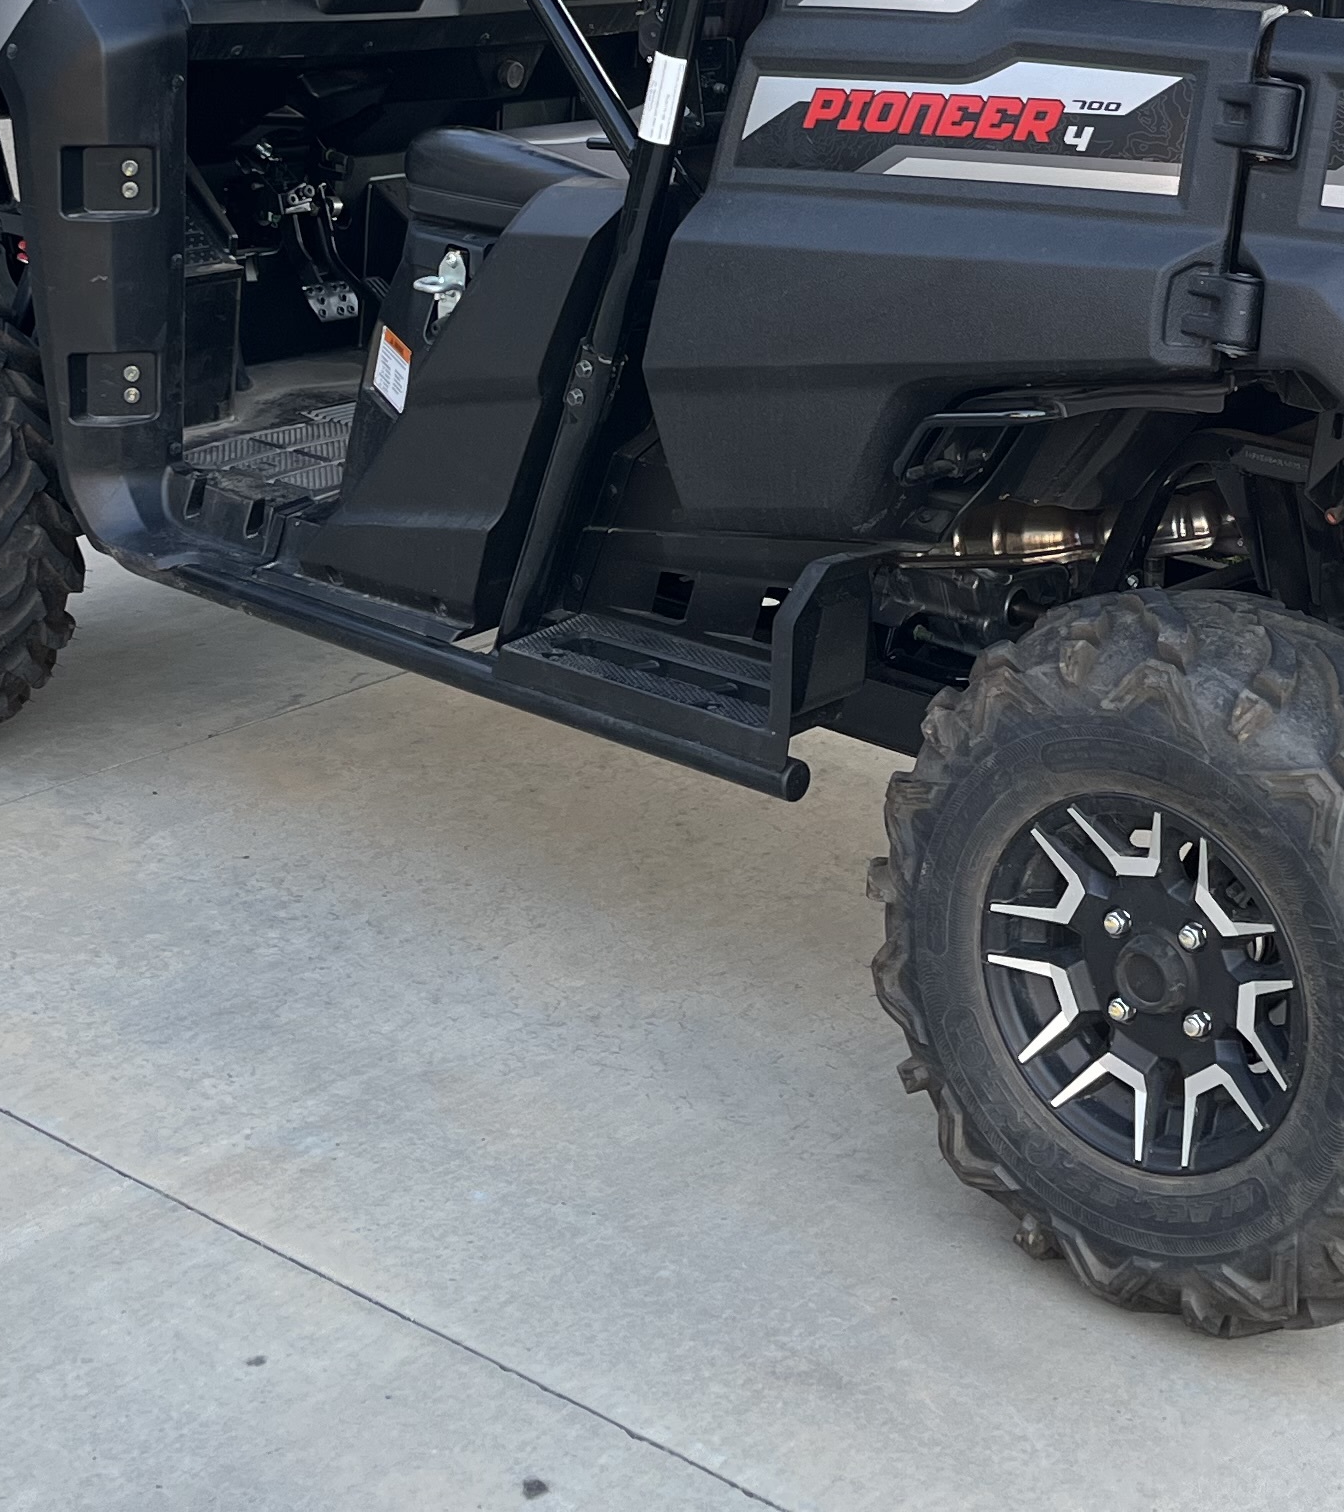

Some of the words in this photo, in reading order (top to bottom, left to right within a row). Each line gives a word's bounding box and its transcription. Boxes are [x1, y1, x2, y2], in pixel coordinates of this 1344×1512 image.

[802, 86, 1066, 143] PIONEER
[1071, 98, 1121, 113] 700
[1063, 124, 1095, 152] 4
